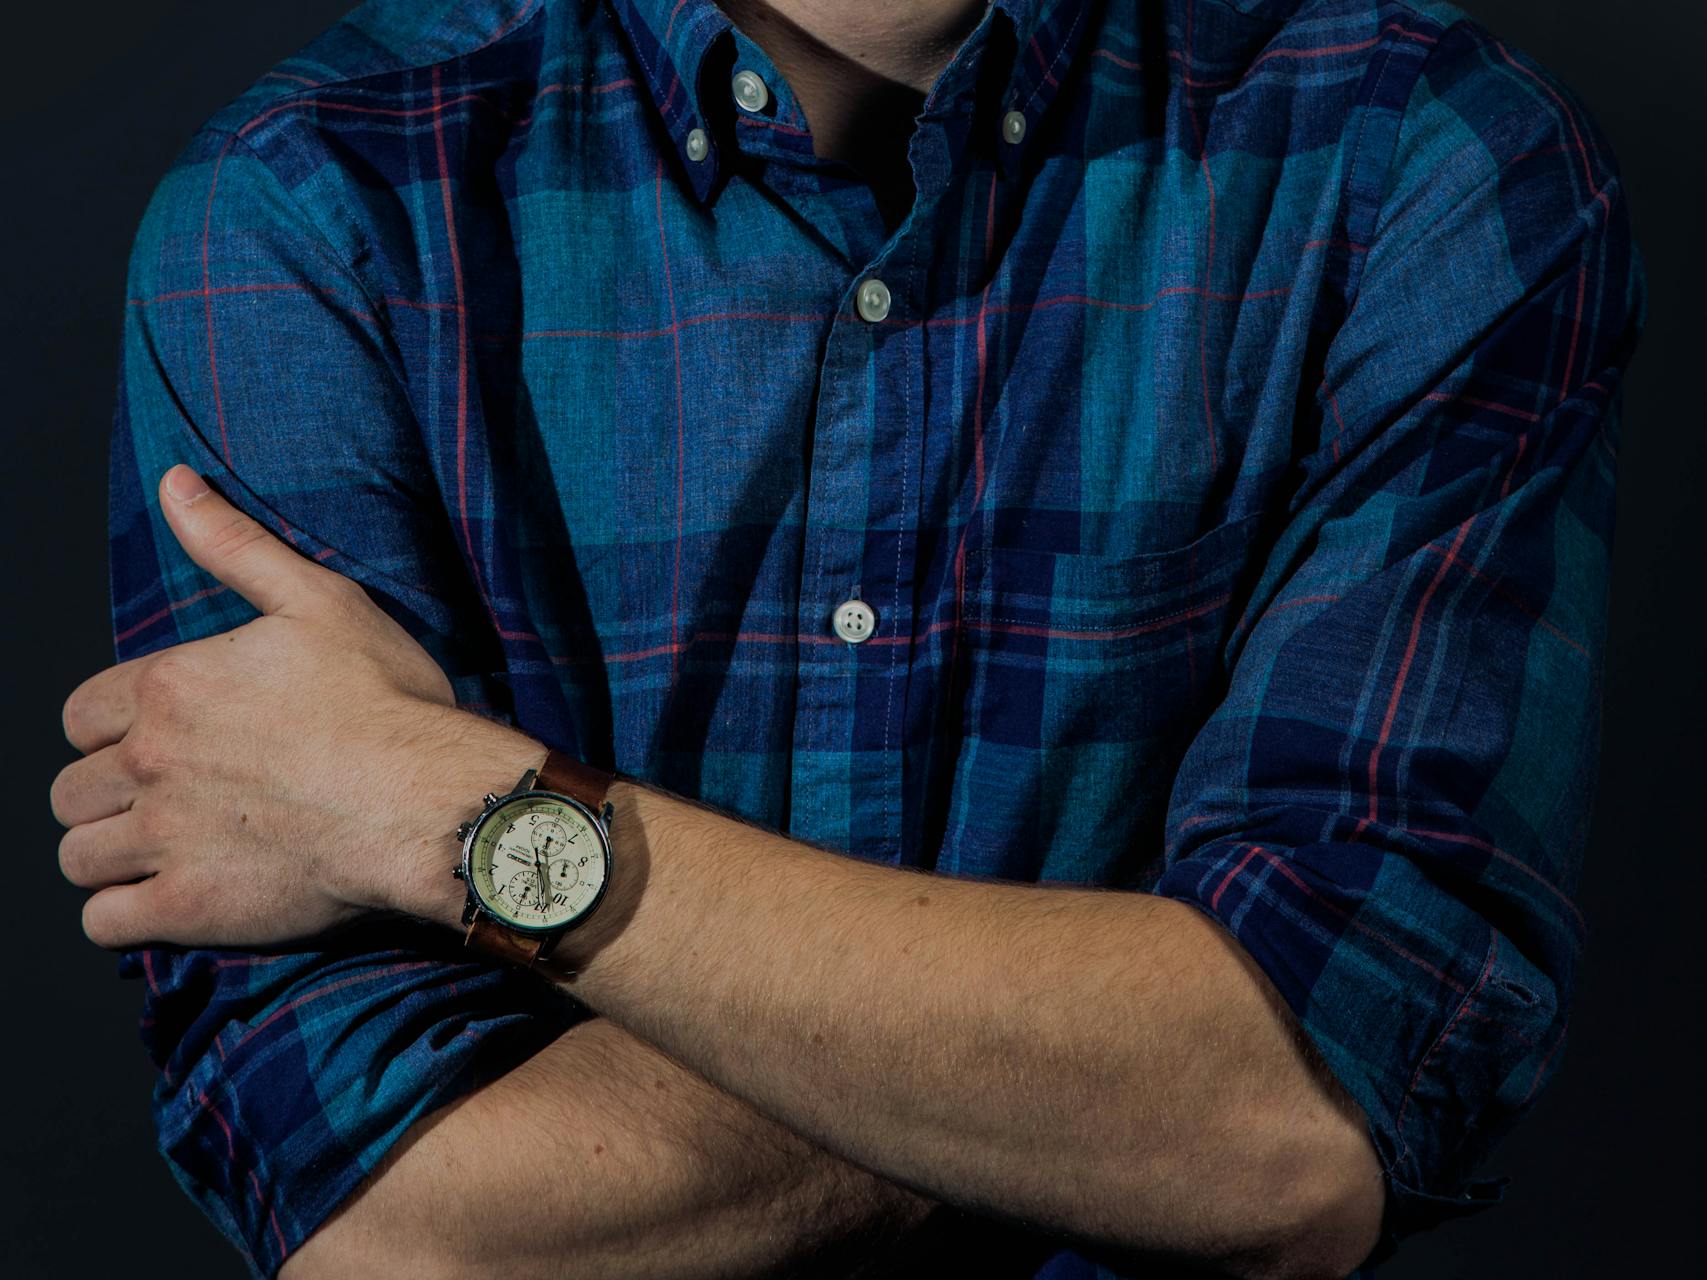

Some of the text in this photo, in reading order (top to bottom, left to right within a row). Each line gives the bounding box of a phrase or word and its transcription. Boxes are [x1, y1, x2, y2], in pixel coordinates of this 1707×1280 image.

[529, 814, 539, 826] 5
[506, 822, 515, 833] 4
[568, 833, 578, 844] 7
[577, 856, 588, 867] 8
[488, 863, 498, 876] 2
[498, 884, 506, 894] 1
[552, 892, 568, 906] 10
